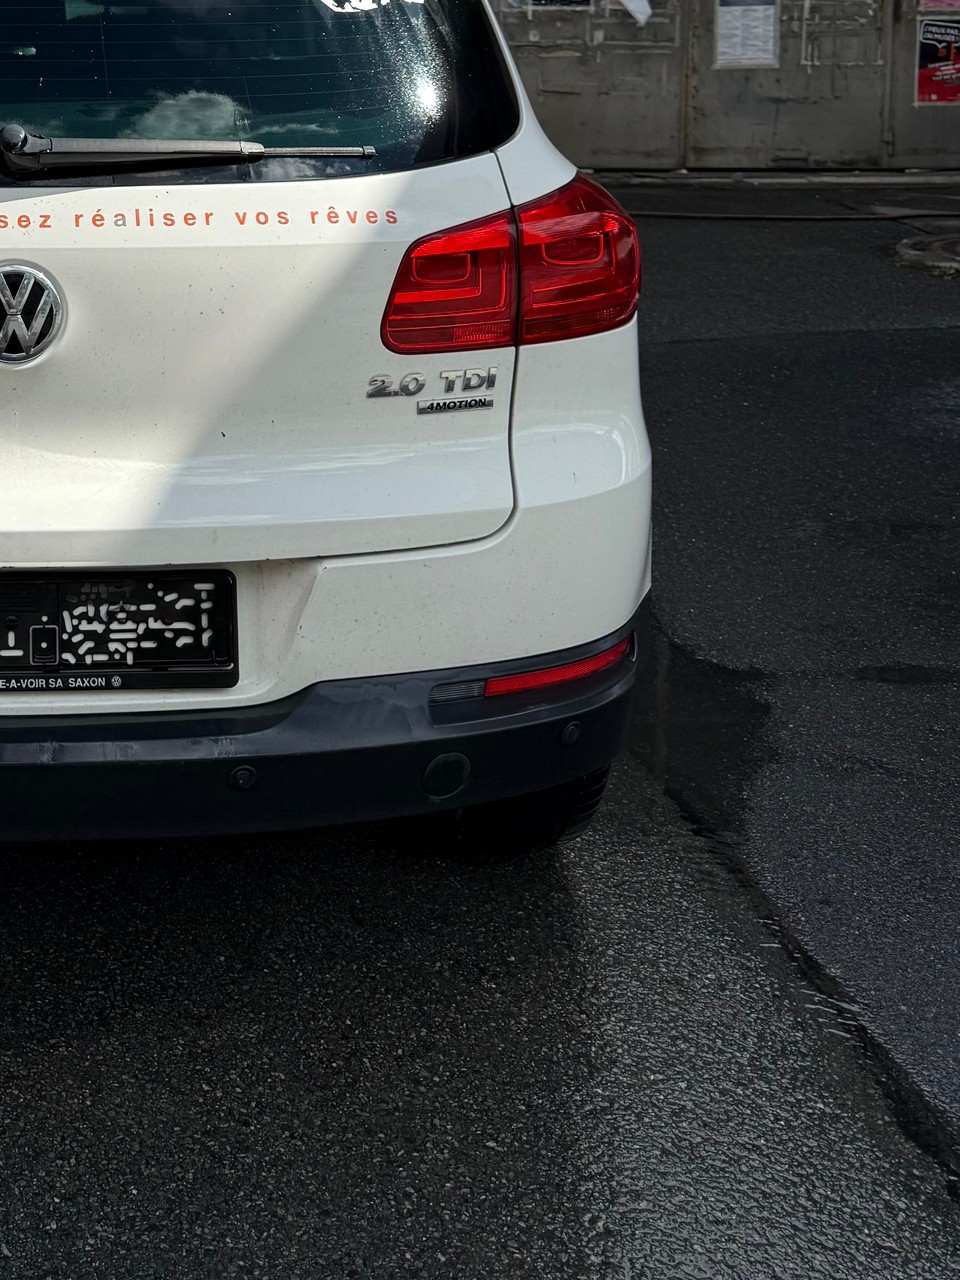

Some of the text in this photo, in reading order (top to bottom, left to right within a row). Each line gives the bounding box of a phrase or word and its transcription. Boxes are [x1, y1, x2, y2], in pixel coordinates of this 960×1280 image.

[74, 208, 214, 228] réaliser
[235, 211, 290, 226] vos
[311, 206, 398, 226] rêves
[366, 366, 498, 399] 2.0 TDI
[426, 398, 487, 412] 4MOTION
[49, 678, 63, 688] SA
[68, 677, 106, 688] SAXON
